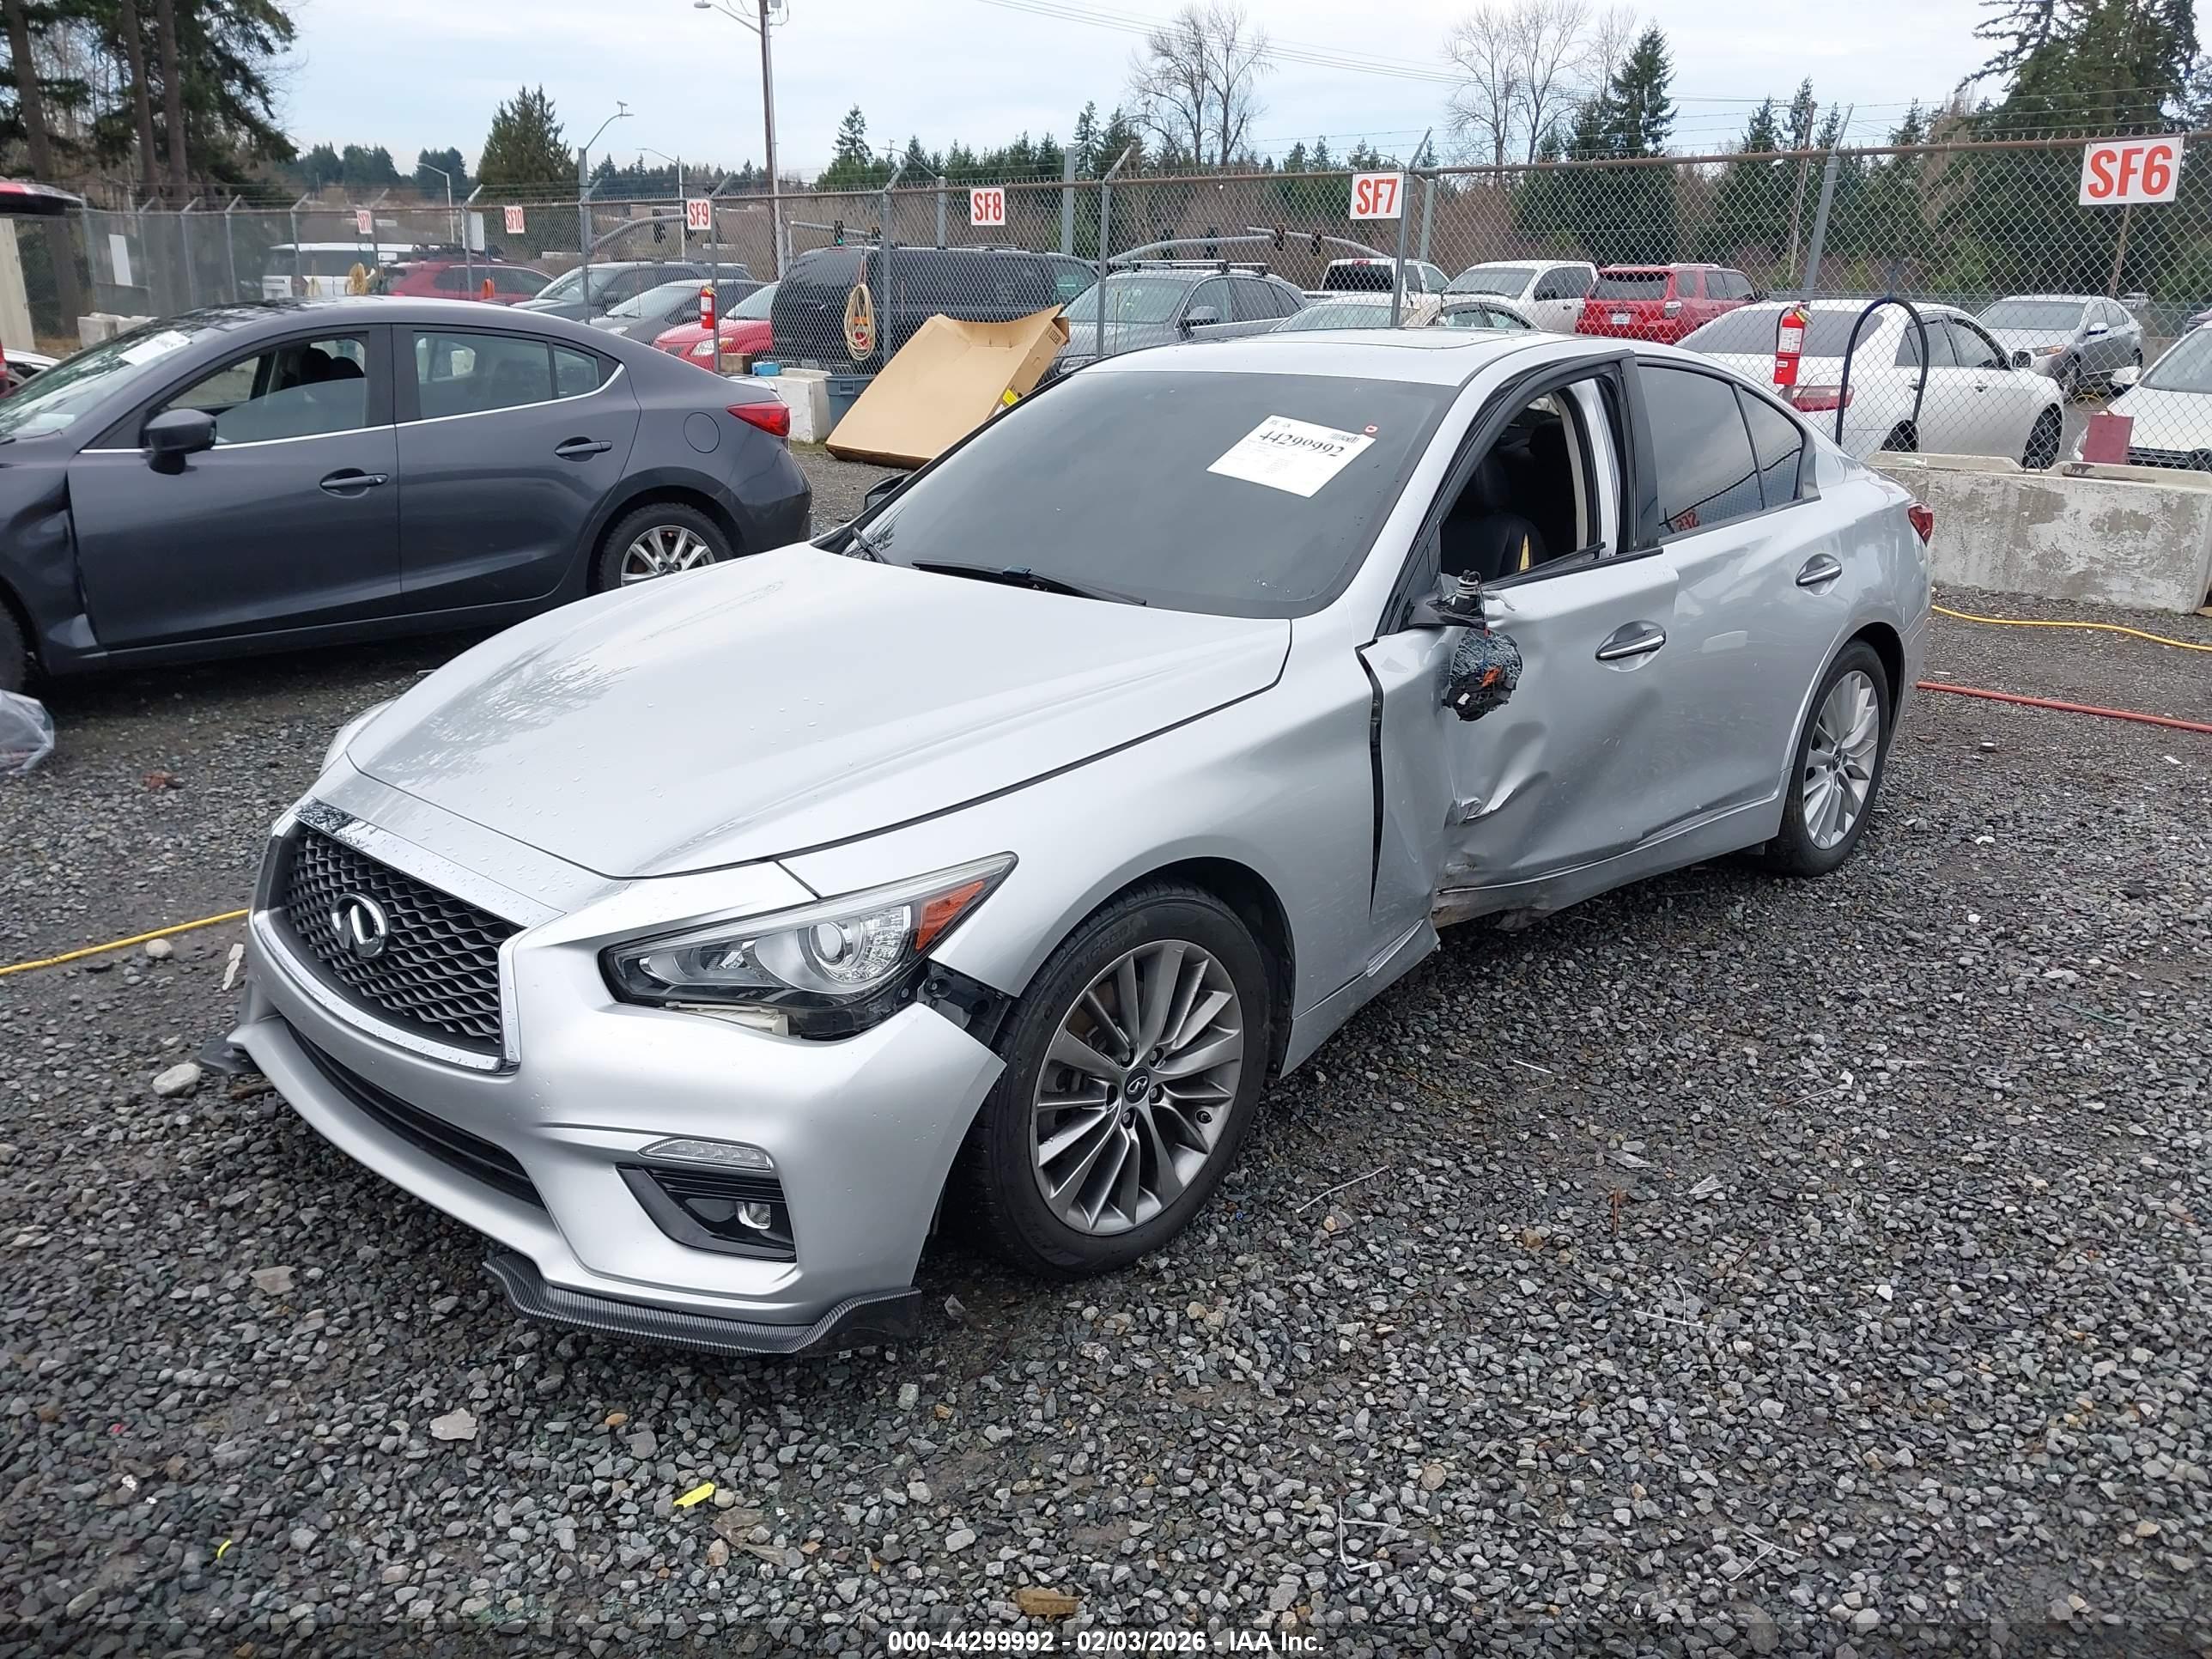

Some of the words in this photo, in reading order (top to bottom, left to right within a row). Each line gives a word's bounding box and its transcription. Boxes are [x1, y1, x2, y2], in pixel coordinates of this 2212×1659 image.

[2087, 144, 2173, 198] SF6
[973, 191, 1003, 222] SF8
[1356, 178, 1398, 215] SF7
[506, 209, 524, 229] SF10
[689, 202, 708, 227] SF9
